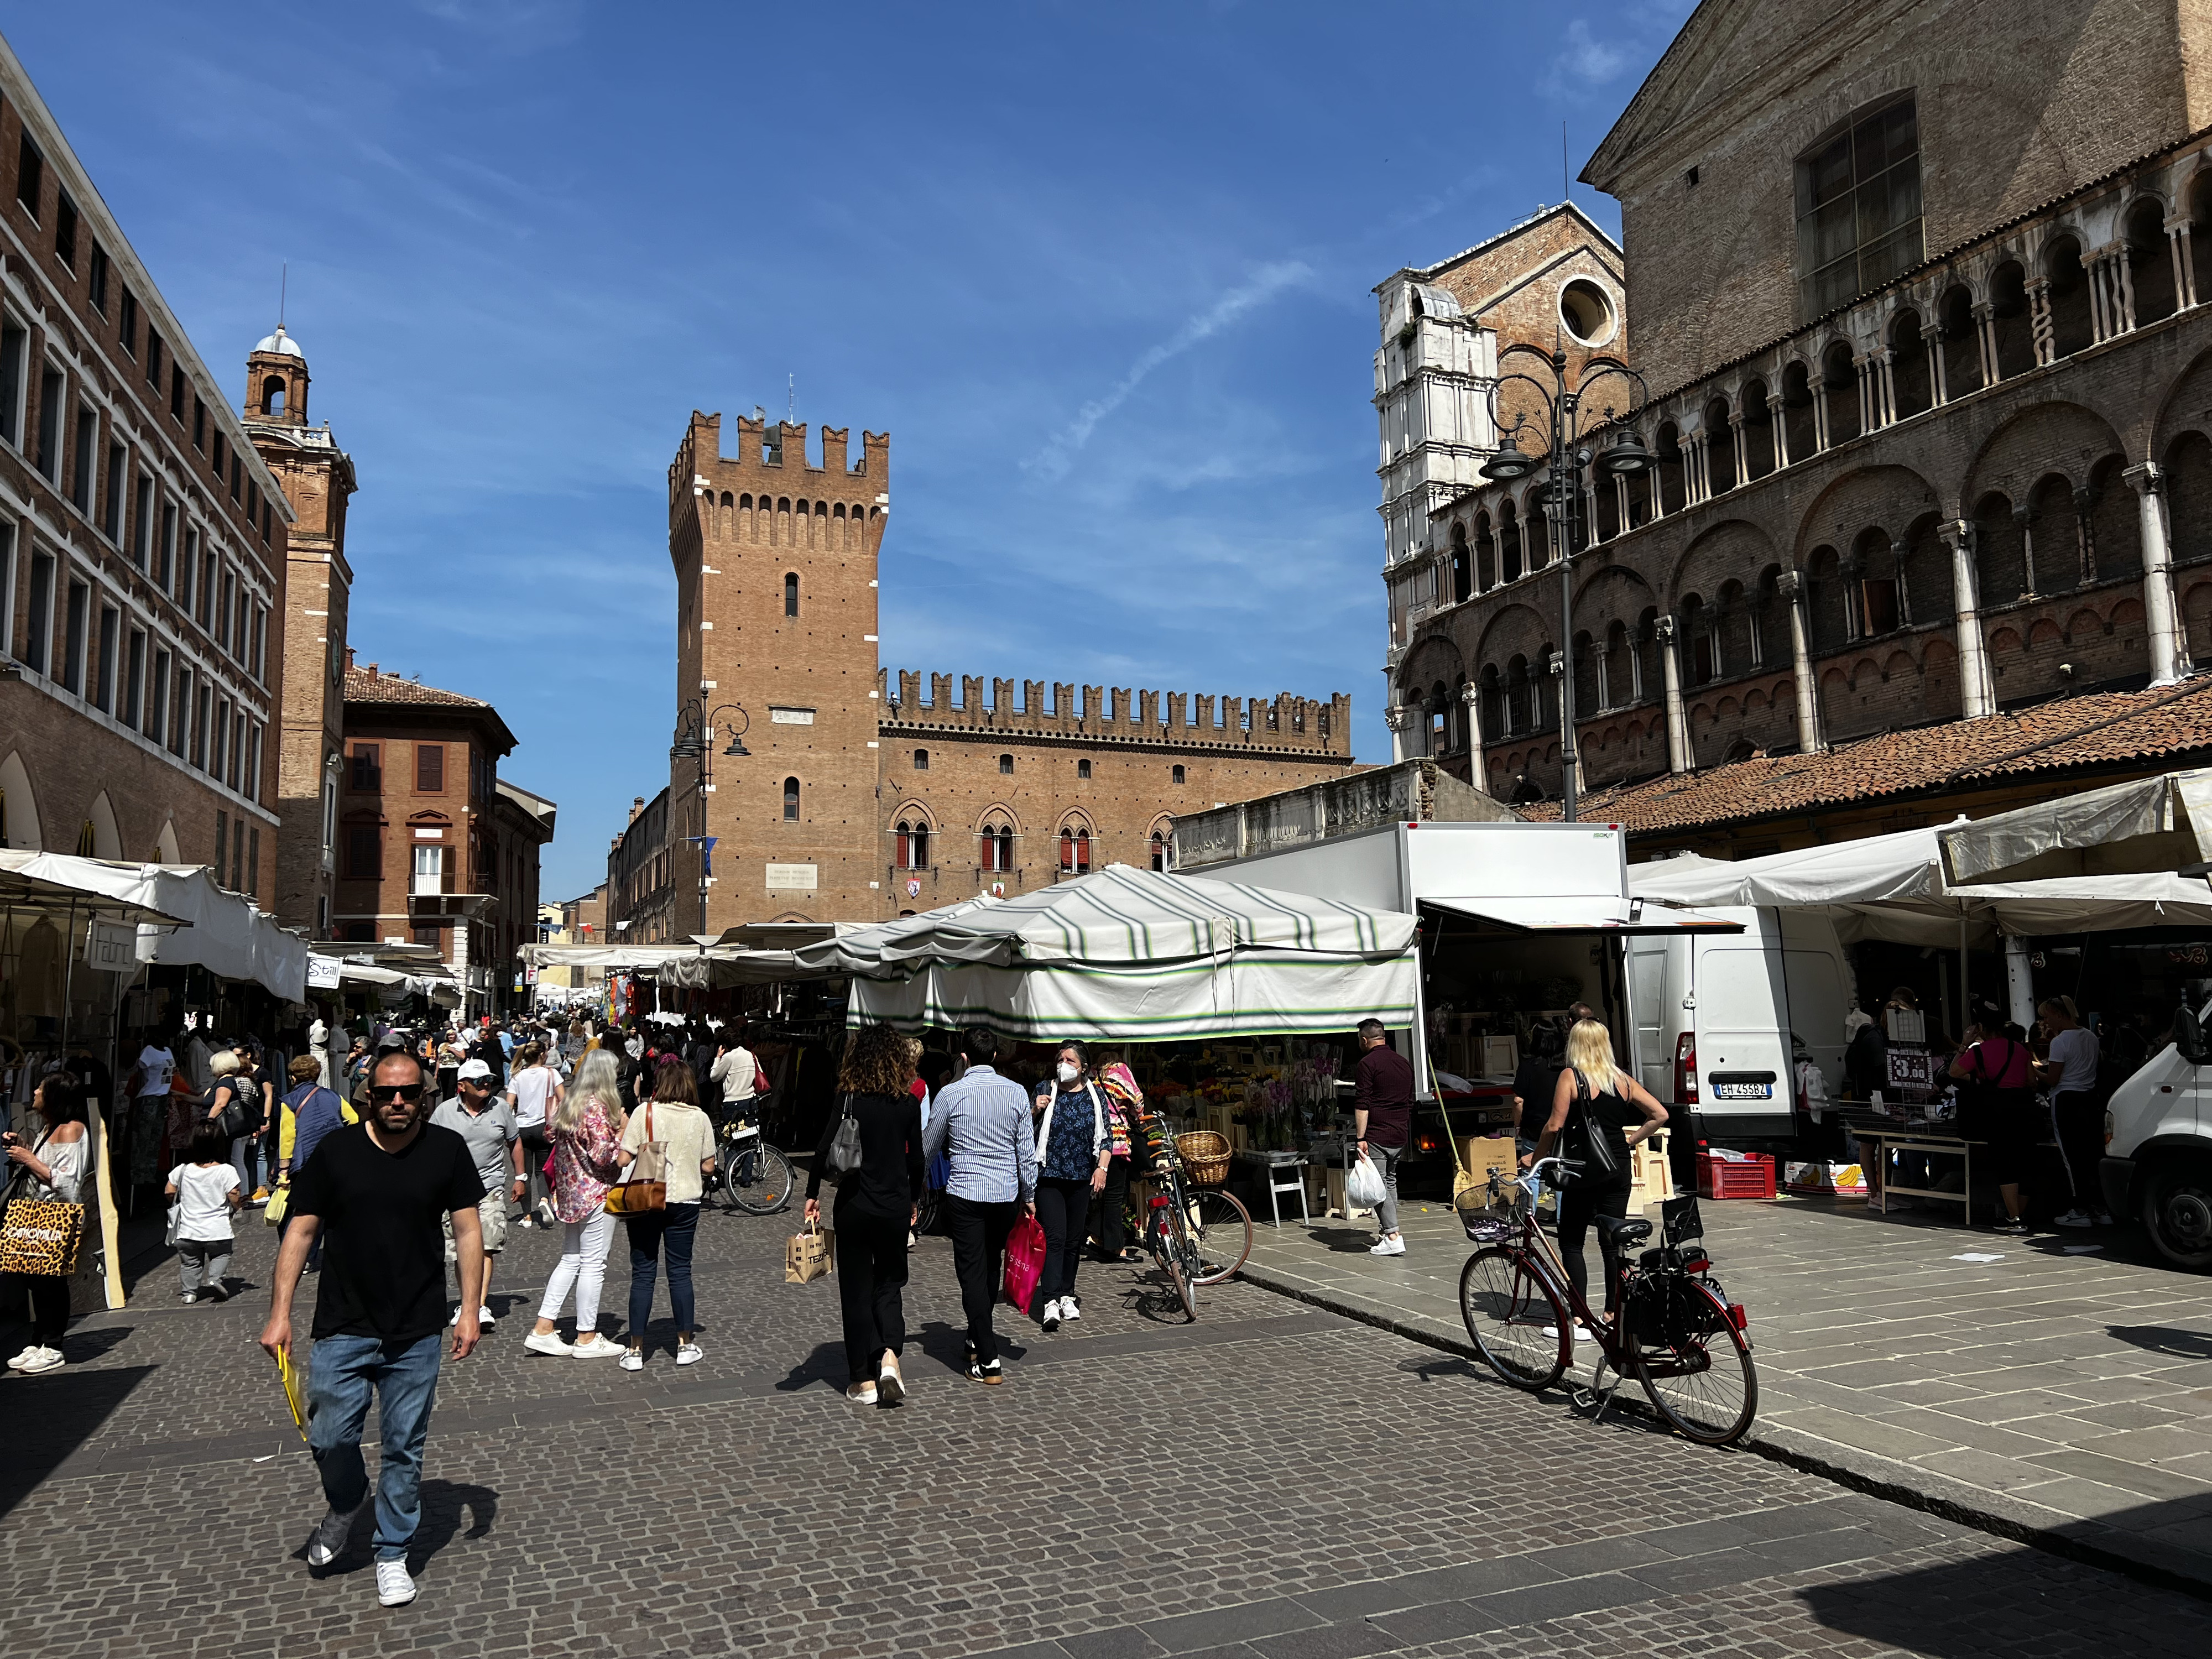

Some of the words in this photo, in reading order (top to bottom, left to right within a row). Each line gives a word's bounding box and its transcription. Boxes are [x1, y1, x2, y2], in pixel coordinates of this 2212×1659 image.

[1720, 1084, 1733, 1094] EH
[1736, 1084, 1766, 1094] 455BZ
[7, 1227, 61, 1241] CAMOMILLA
